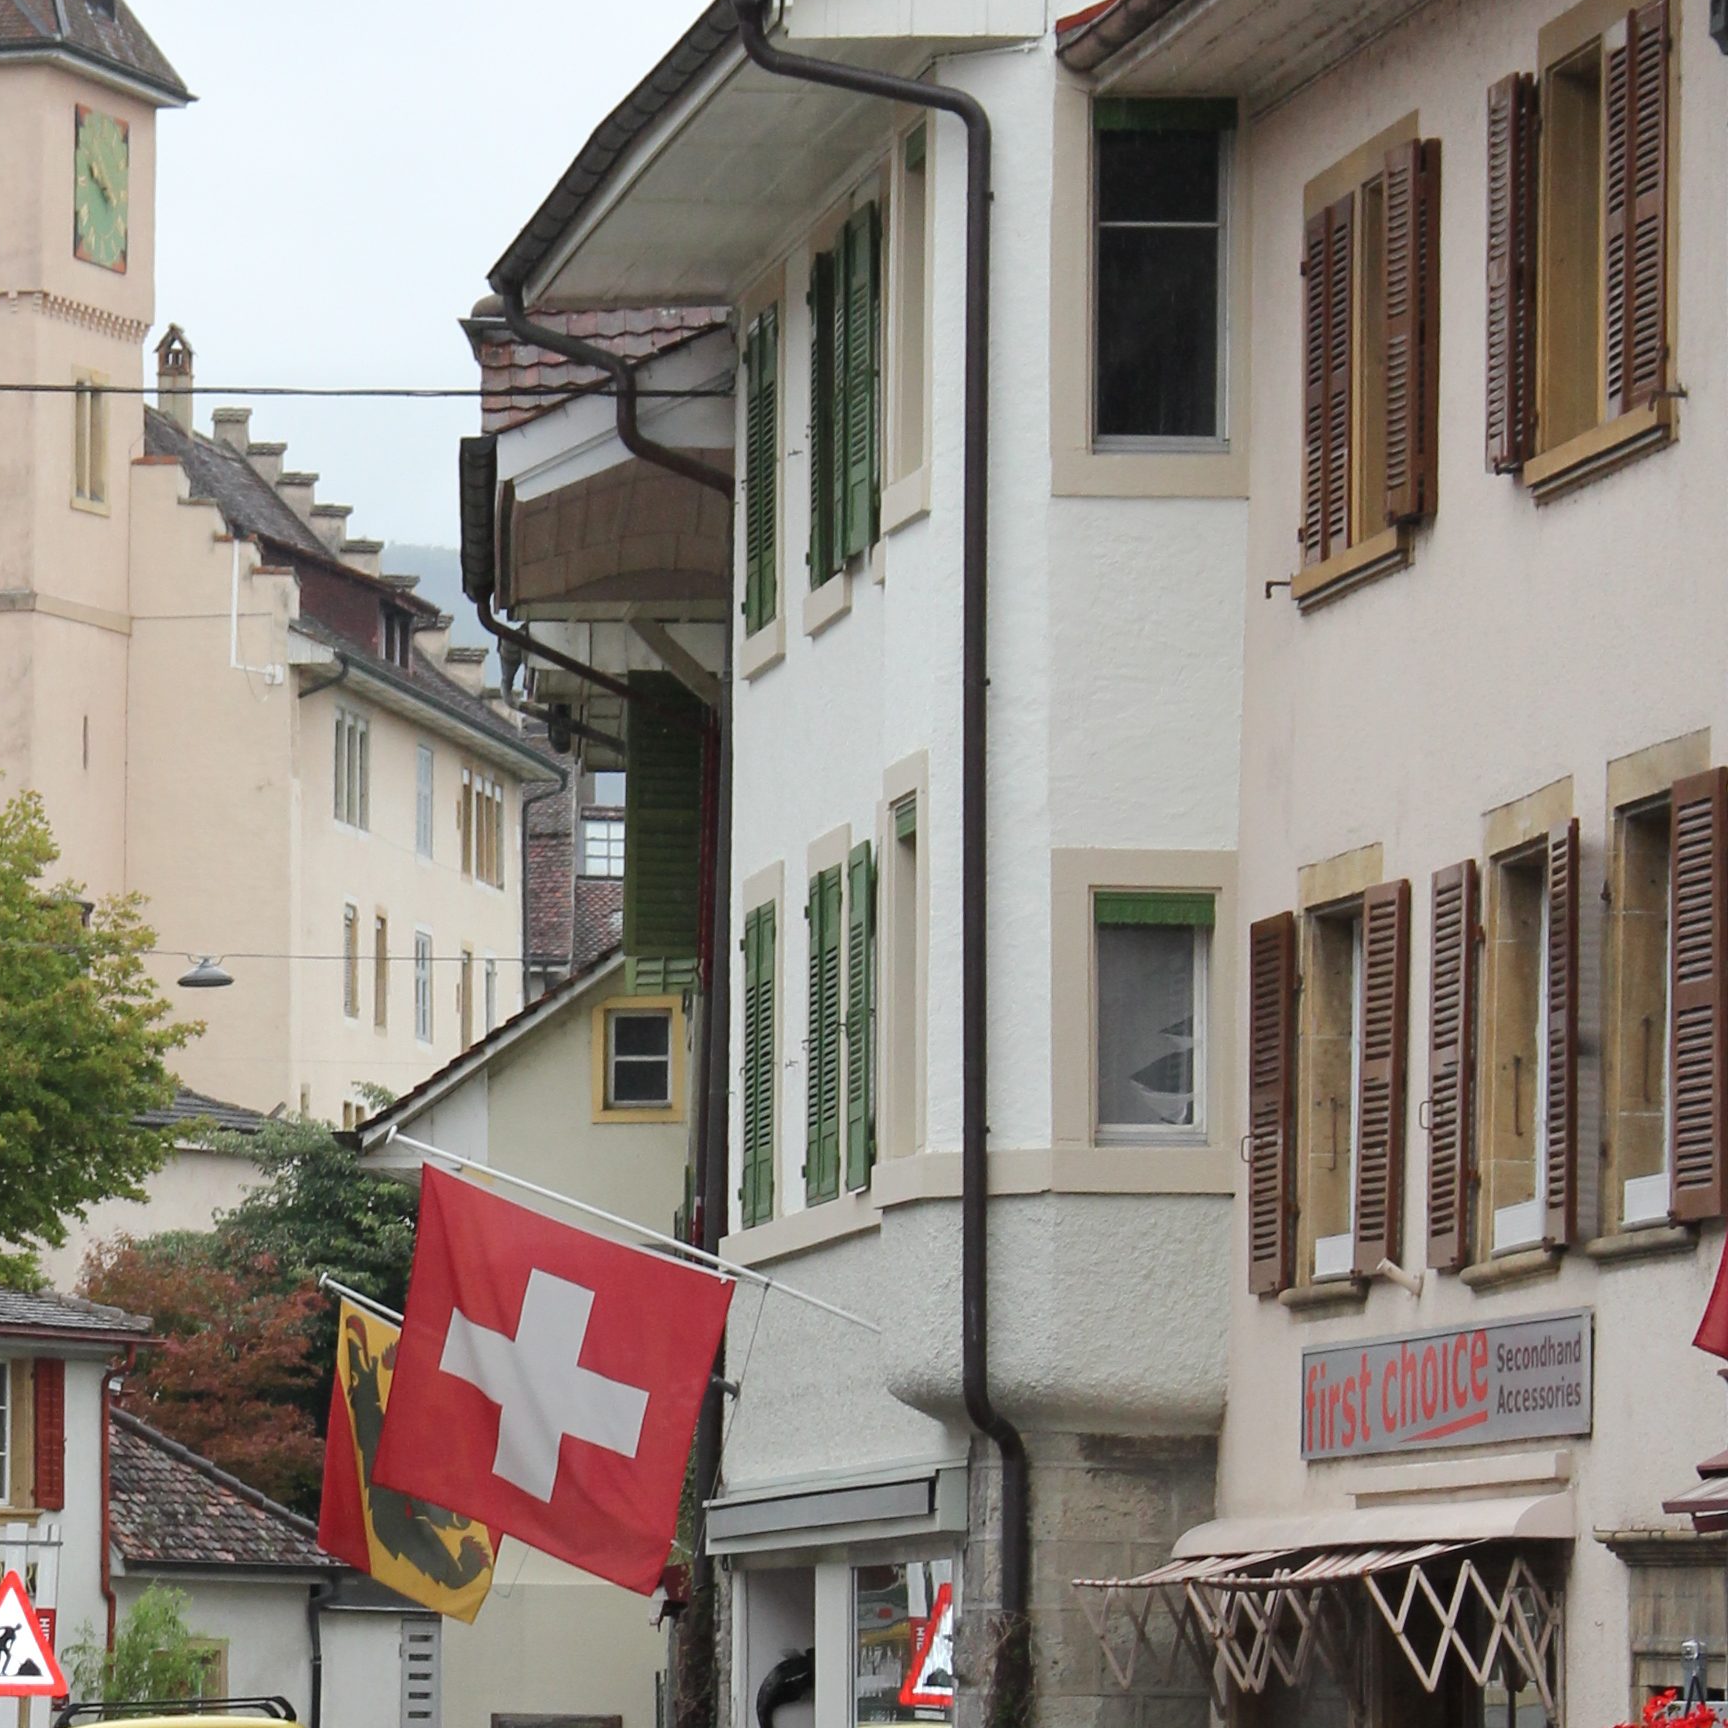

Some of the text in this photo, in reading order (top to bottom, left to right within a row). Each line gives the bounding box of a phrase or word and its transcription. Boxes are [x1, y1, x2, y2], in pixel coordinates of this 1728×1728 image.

[1497, 1331, 1582, 1373] Secondhand
[1306, 1328, 1488, 1452] first choice
[1497, 1376, 1582, 1414] Accessories
